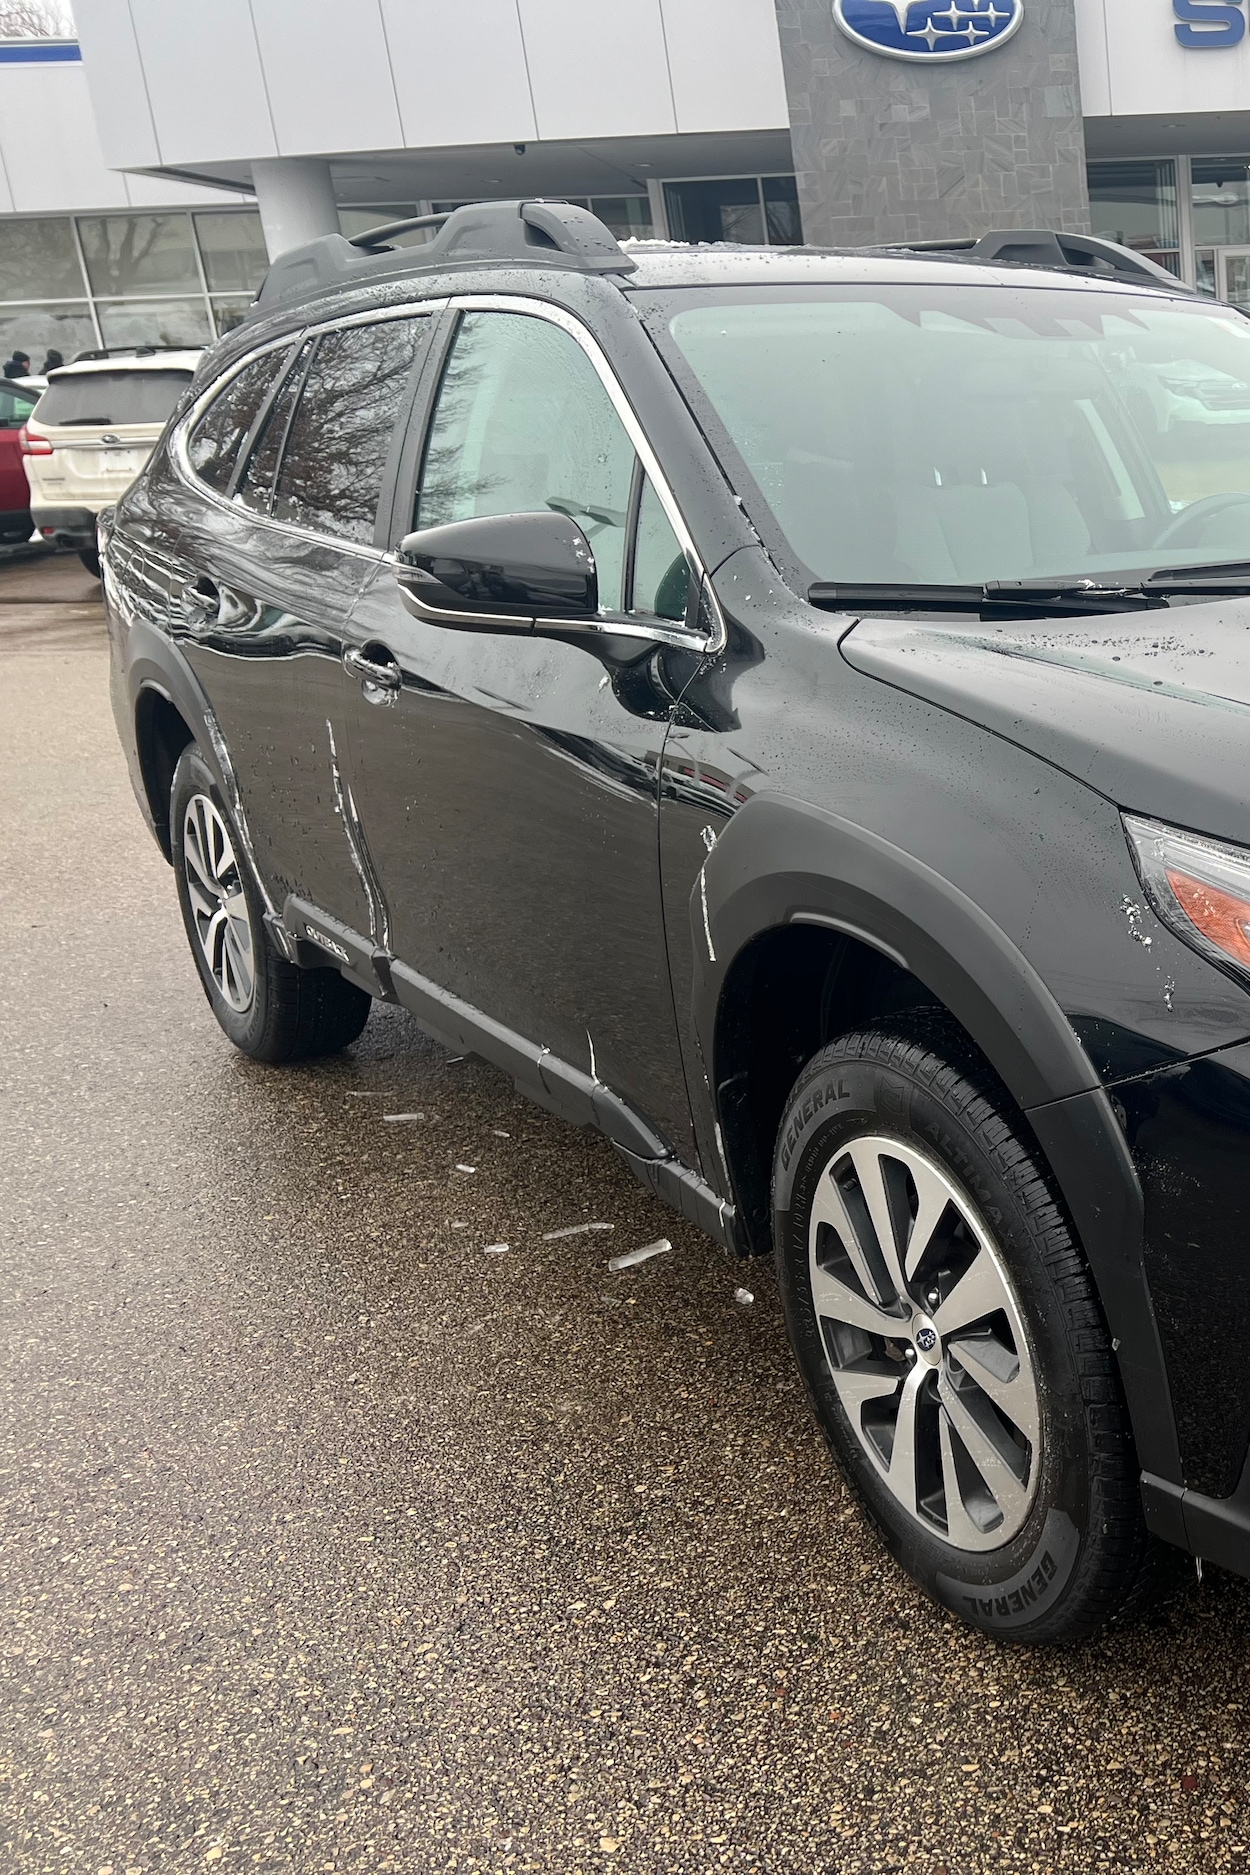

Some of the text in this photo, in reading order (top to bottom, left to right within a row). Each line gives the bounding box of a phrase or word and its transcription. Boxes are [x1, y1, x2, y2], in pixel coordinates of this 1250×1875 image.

[305, 924, 350, 962] OUTBACK
[780, 1078, 851, 1171] GENERAL
[961, 1551, 1058, 1617] GENERAL
